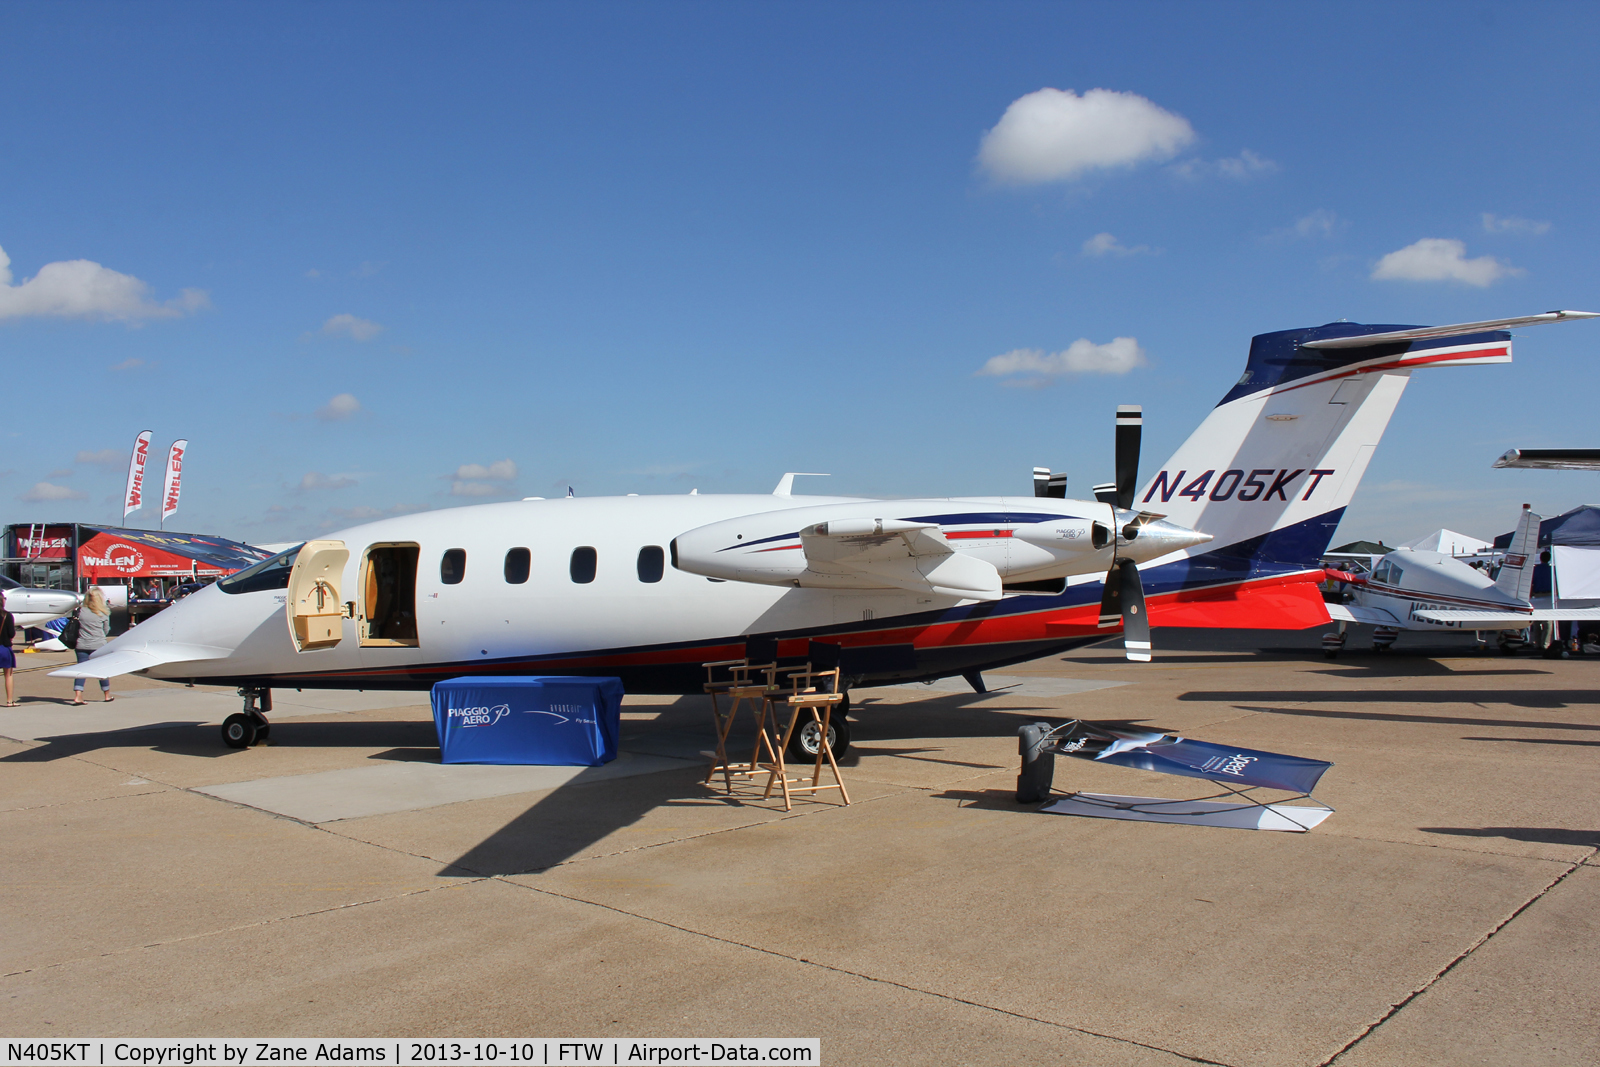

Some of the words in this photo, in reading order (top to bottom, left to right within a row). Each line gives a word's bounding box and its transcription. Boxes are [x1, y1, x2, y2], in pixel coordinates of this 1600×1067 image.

[128, 438, 149, 507] WHELEN
[164, 446, 184, 512] WHELEN
[1142, 469, 1335, 503] N405KT
[18, 536, 72, 549] WHELEN
[82, 555, 135, 566] WHELEN
[448, 706, 489, 718] PIAGGIO
[463, 714, 490, 725] AERO
